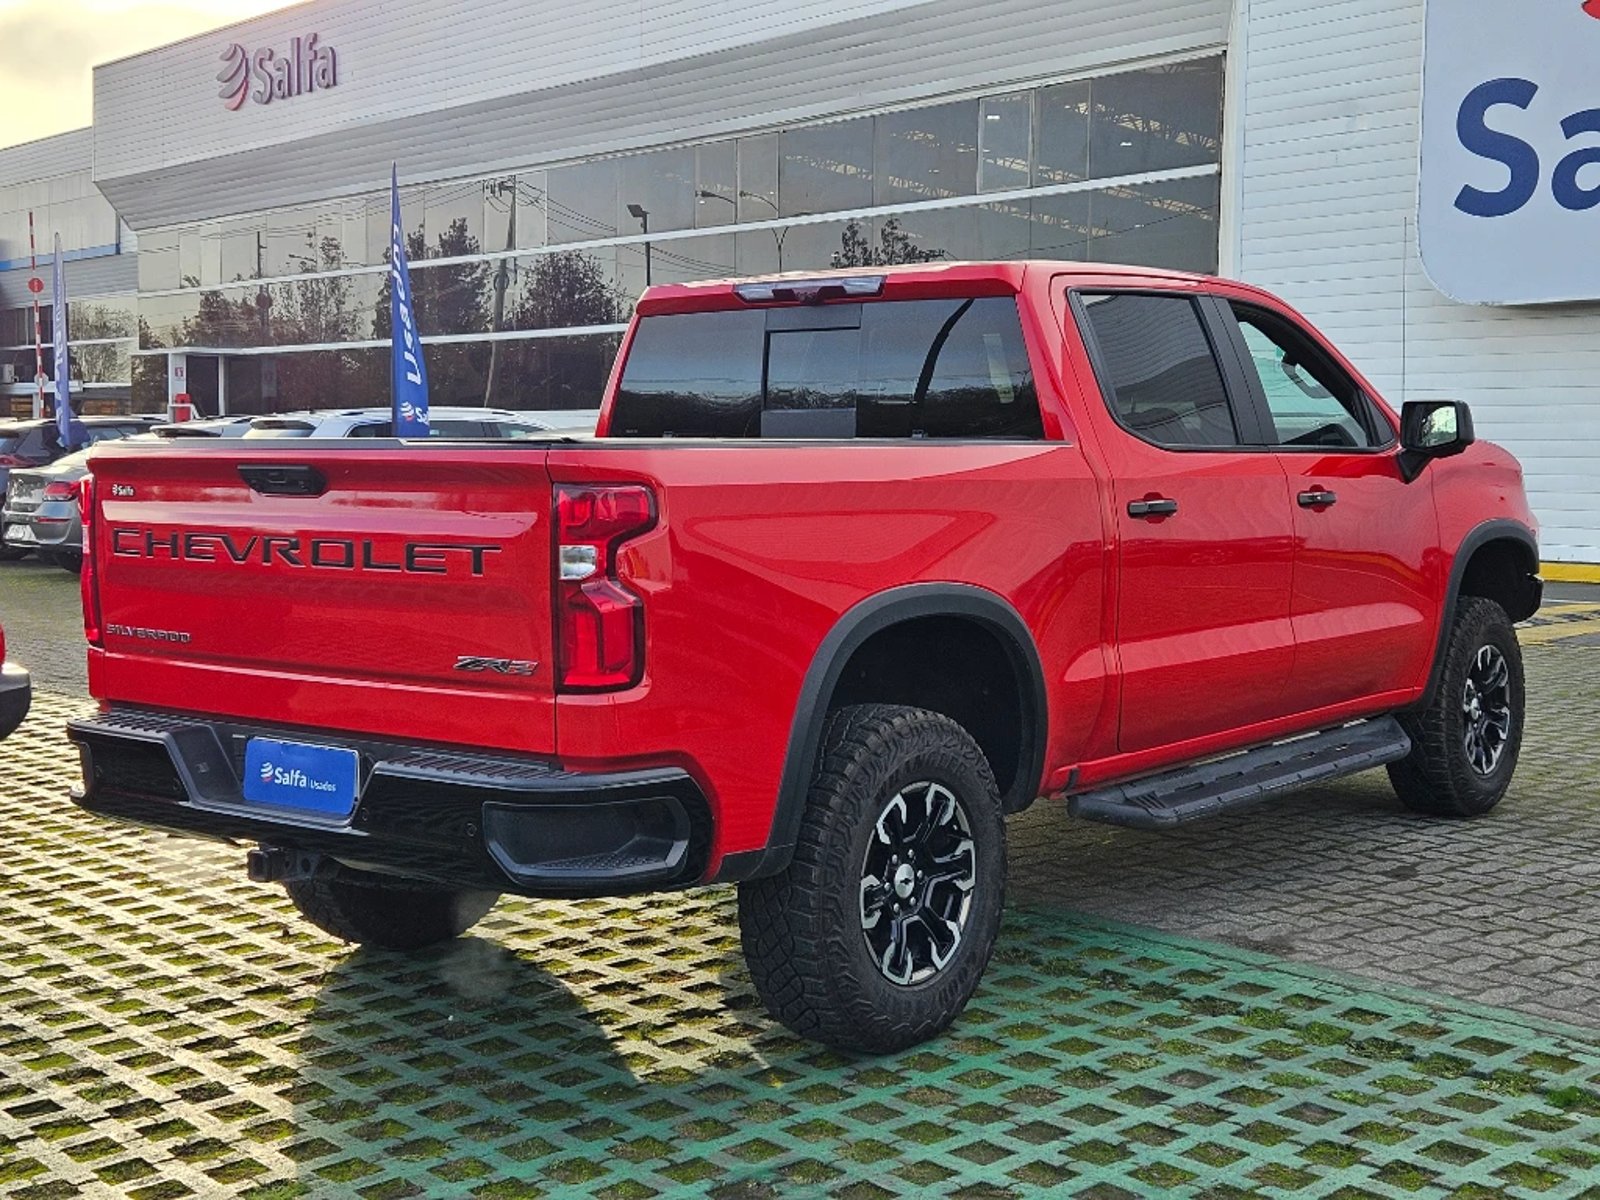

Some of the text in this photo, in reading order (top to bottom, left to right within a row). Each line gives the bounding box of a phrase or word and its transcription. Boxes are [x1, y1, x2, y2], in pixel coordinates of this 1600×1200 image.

[252, 32, 337, 105] Salfa
[112, 527, 502, 577] CHEVROLET
[106, 623, 190, 643] SILVERADO
[453, 656, 538, 676] ZR2
[274, 767, 337, 793] Salfa Usados
